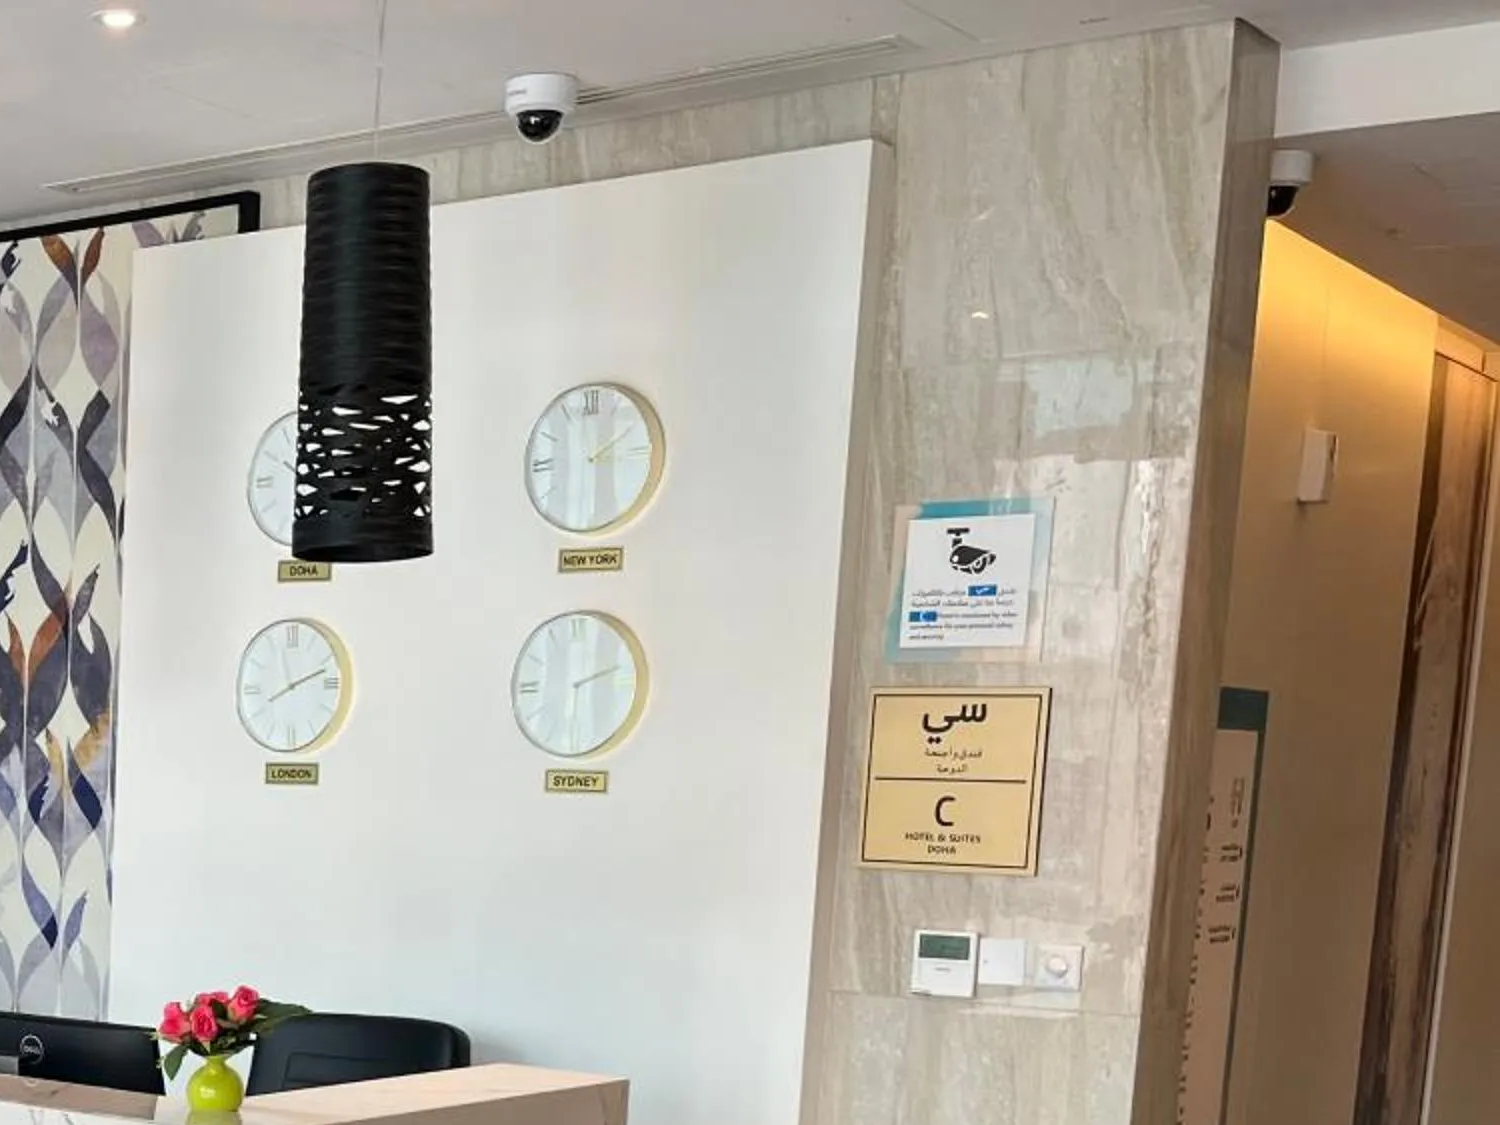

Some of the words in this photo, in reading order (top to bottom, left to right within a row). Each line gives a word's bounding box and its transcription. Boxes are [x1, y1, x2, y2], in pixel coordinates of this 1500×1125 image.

[563, 555, 585, 567] NEW
[588, 553, 618, 566] YORK
[288, 565, 319, 577] DOHA
[922, 703, 988, 745] سي
[271, 767, 312, 779] LONDON
[552, 775, 599, 787] SYDNEY
[934, 795, 956, 827] C
[905, 832, 934, 842] HOTEL
[949, 834, 981, 844] SUITES
[927, 846, 957, 855] DOHA
